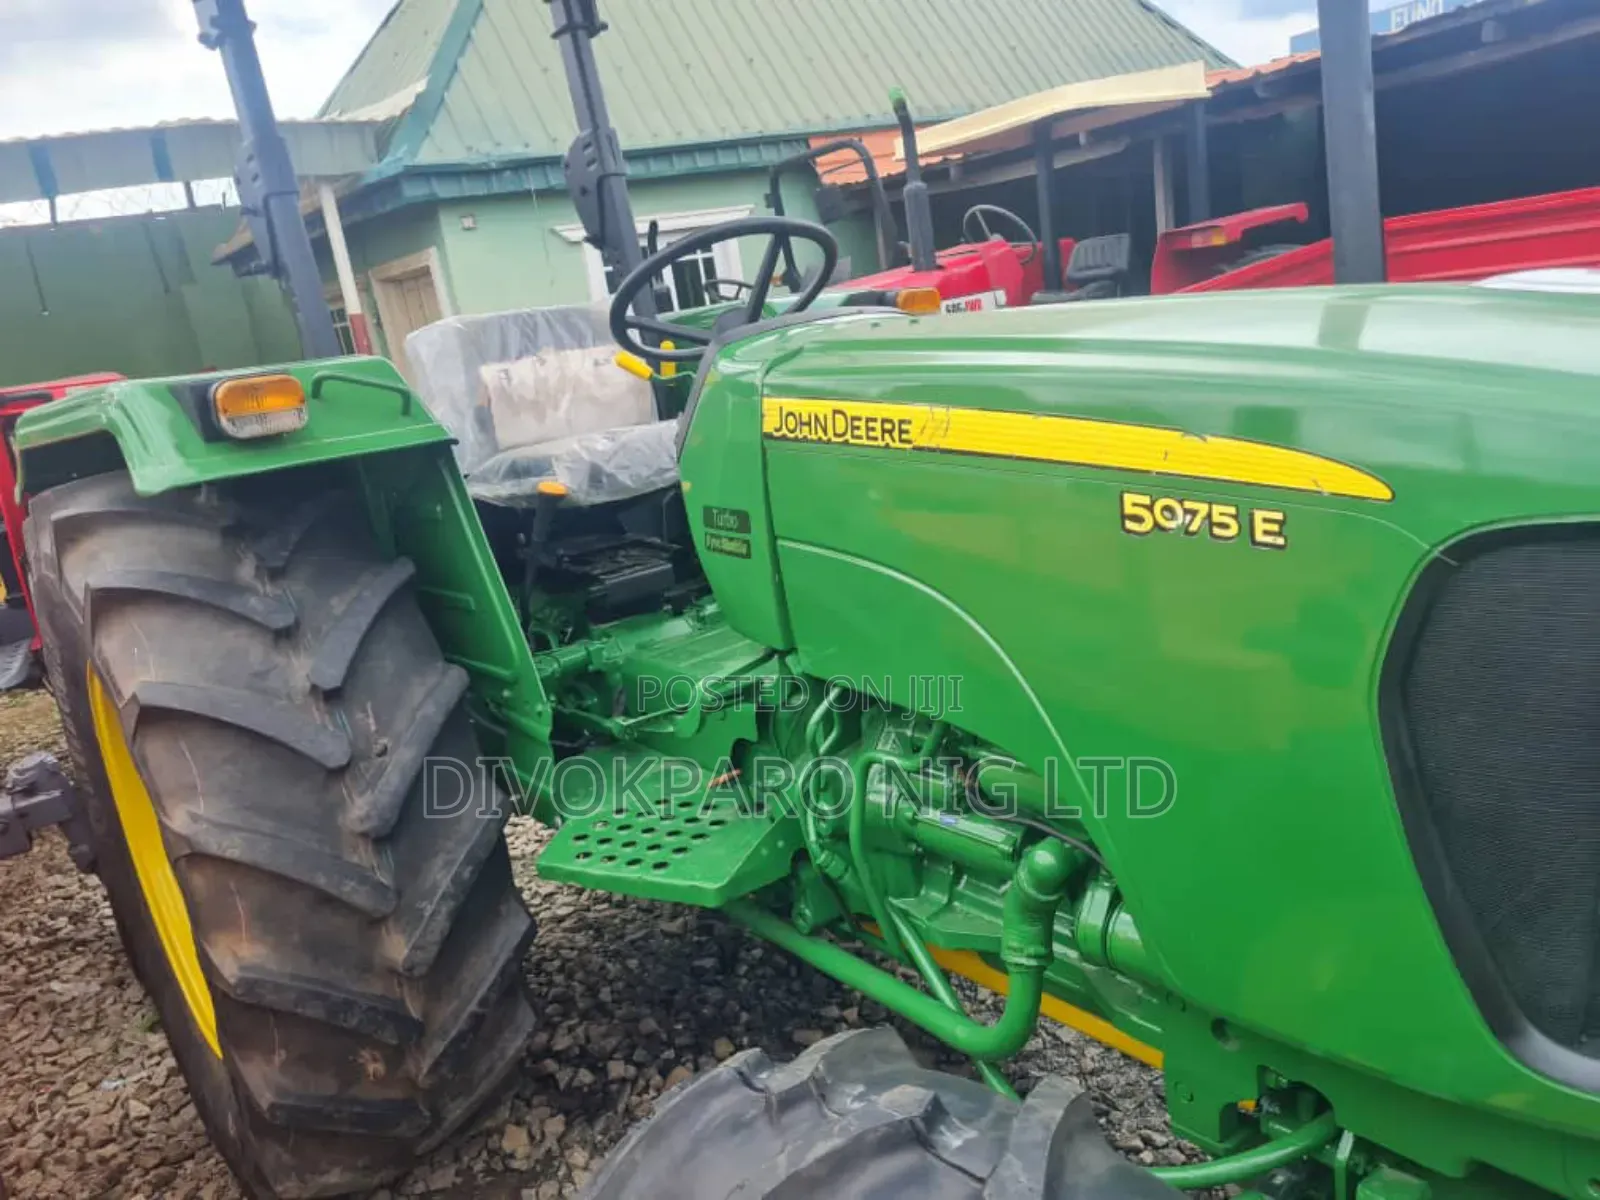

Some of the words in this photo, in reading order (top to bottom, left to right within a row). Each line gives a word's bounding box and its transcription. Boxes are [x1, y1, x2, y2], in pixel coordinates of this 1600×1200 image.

[774, 405, 828, 437] JOHN
[832, 408, 914, 445] DEERE
[1121, 491, 1241, 541] 5075
[1249, 508, 1288, 549] E
